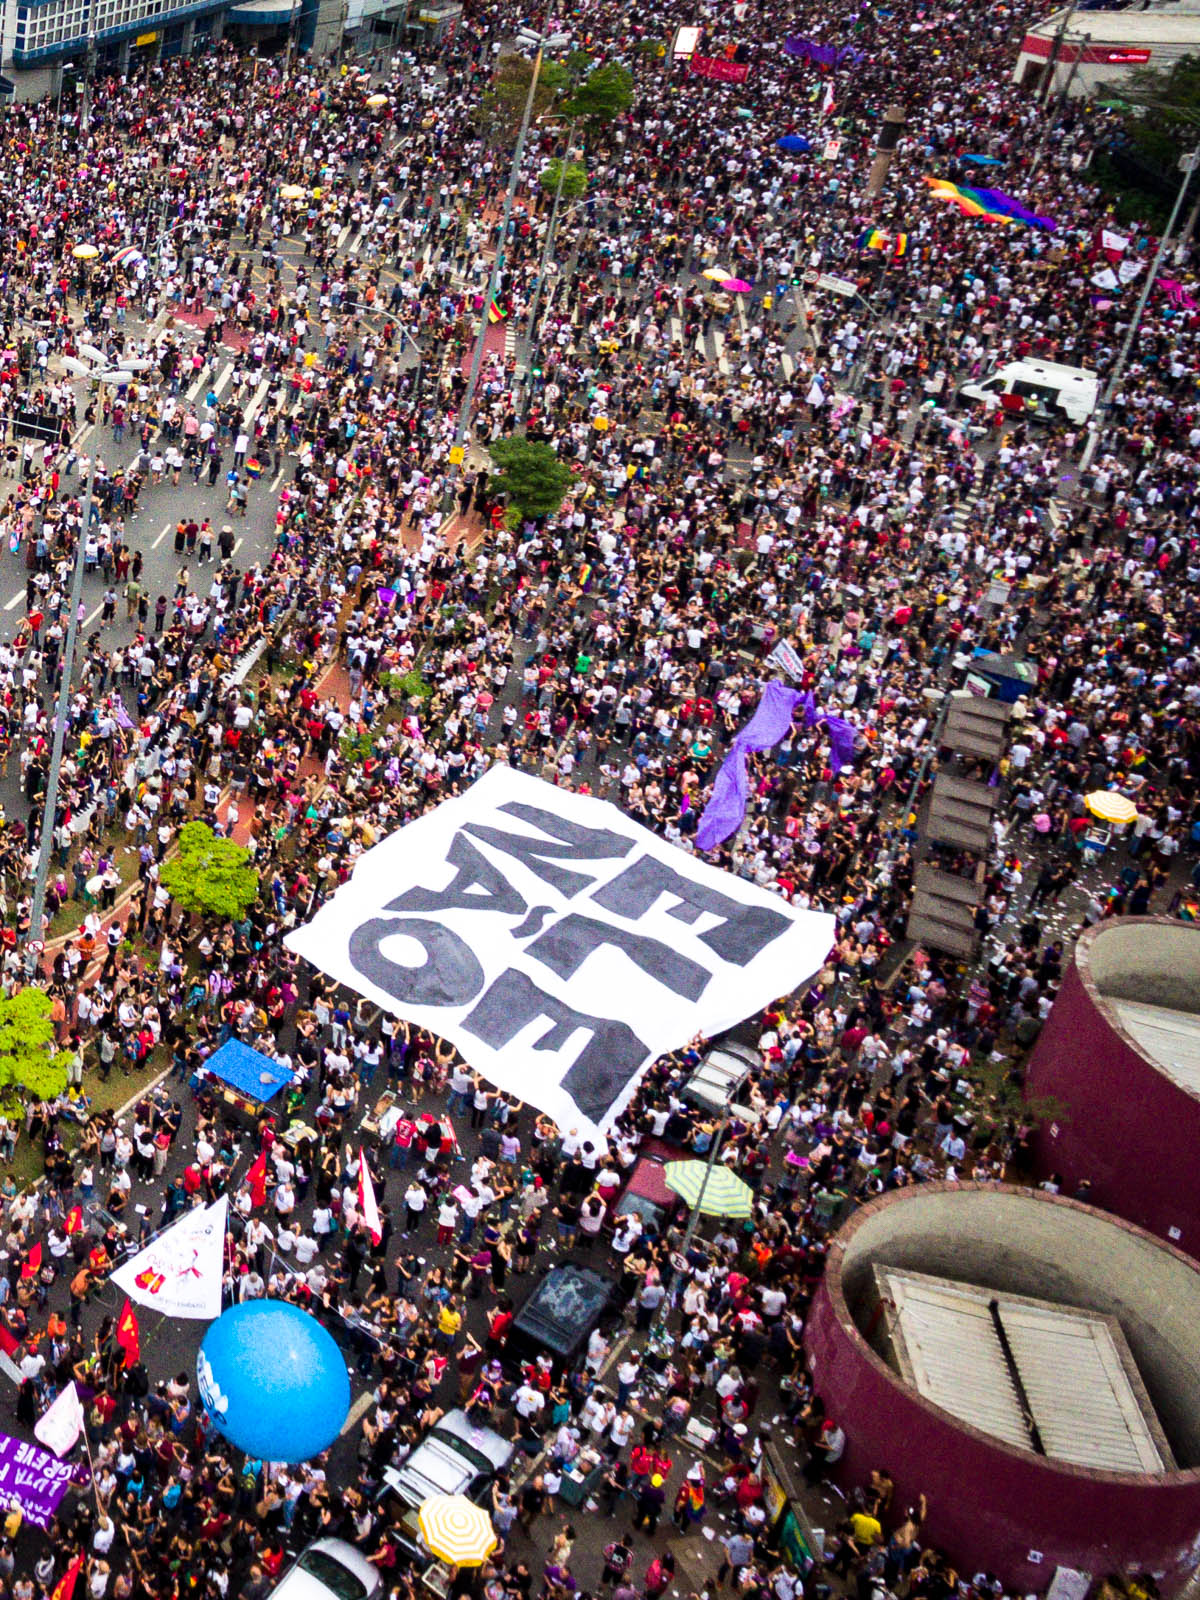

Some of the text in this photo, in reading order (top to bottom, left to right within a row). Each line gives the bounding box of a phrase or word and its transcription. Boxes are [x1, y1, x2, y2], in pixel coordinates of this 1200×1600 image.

[349, 801, 637, 1006] NÃO
[459, 855, 794, 1124] ELE
[14, 1443, 76, 1482] GREVE
[15, 1467, 61, 1496] LUTA
